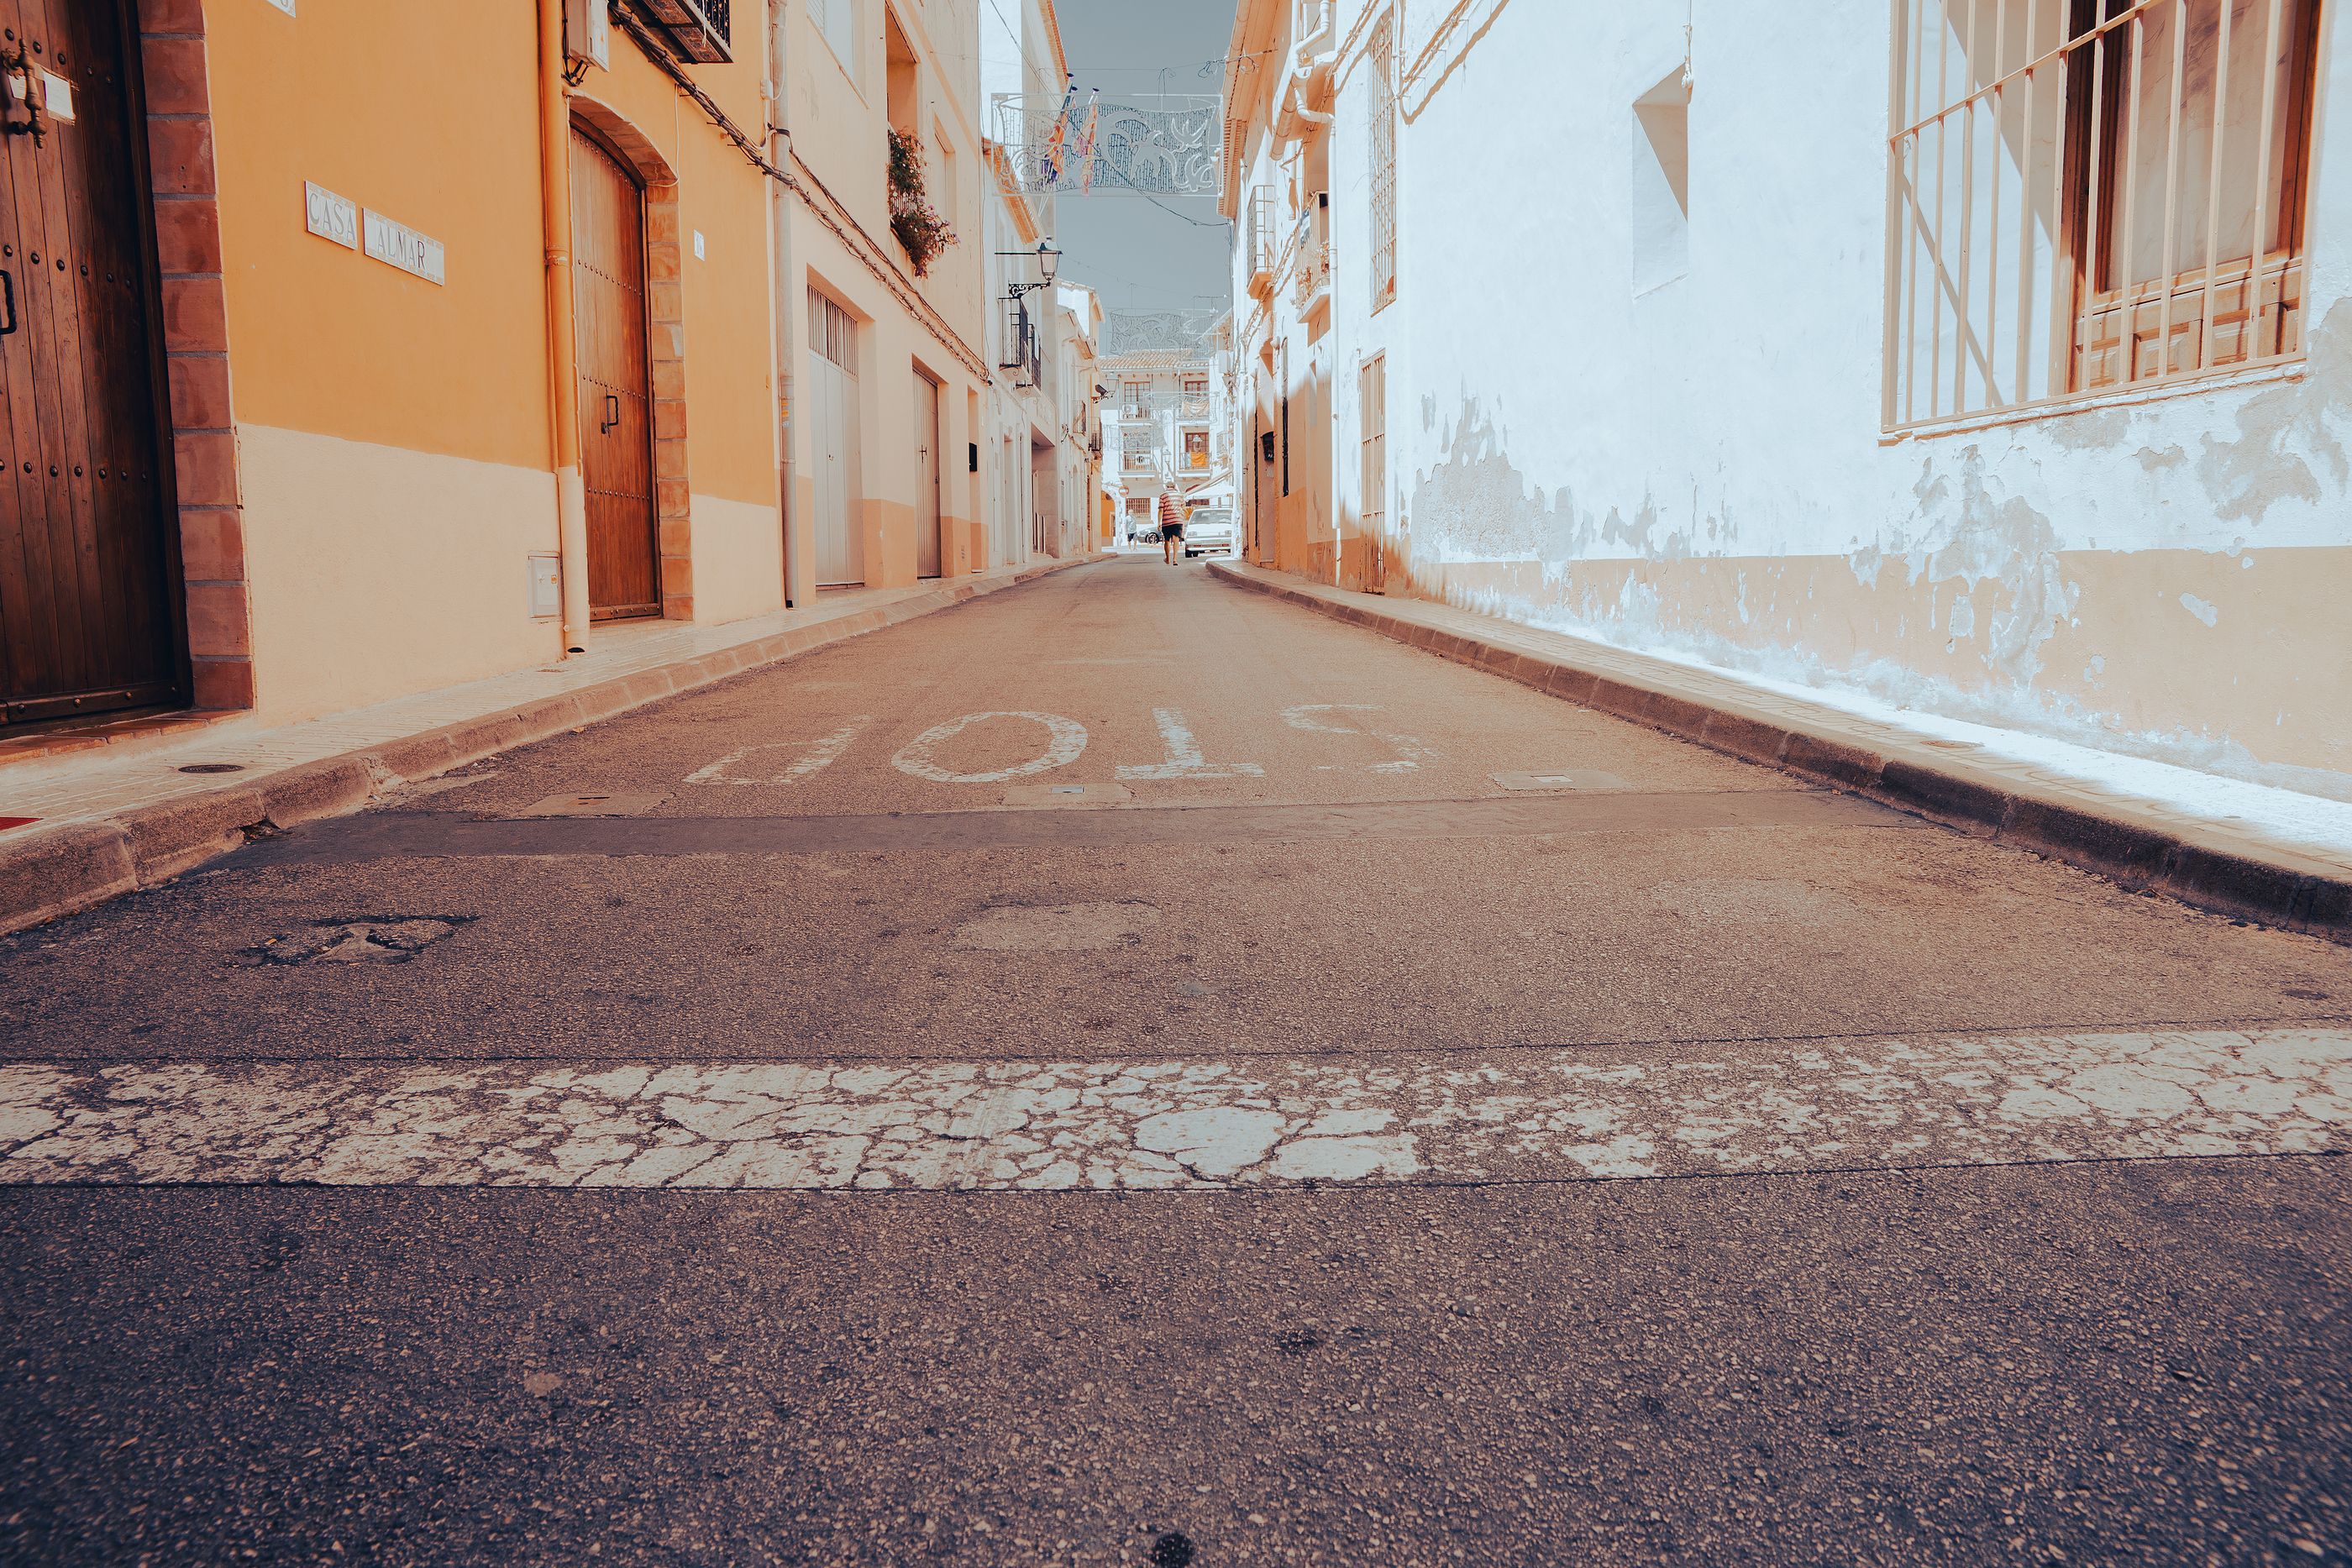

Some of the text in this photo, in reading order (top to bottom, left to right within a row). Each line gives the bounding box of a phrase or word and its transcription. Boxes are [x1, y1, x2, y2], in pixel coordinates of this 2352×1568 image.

[308, 193, 426, 269] CASA ALMAR
[683, 704, 1439, 784] STOP
